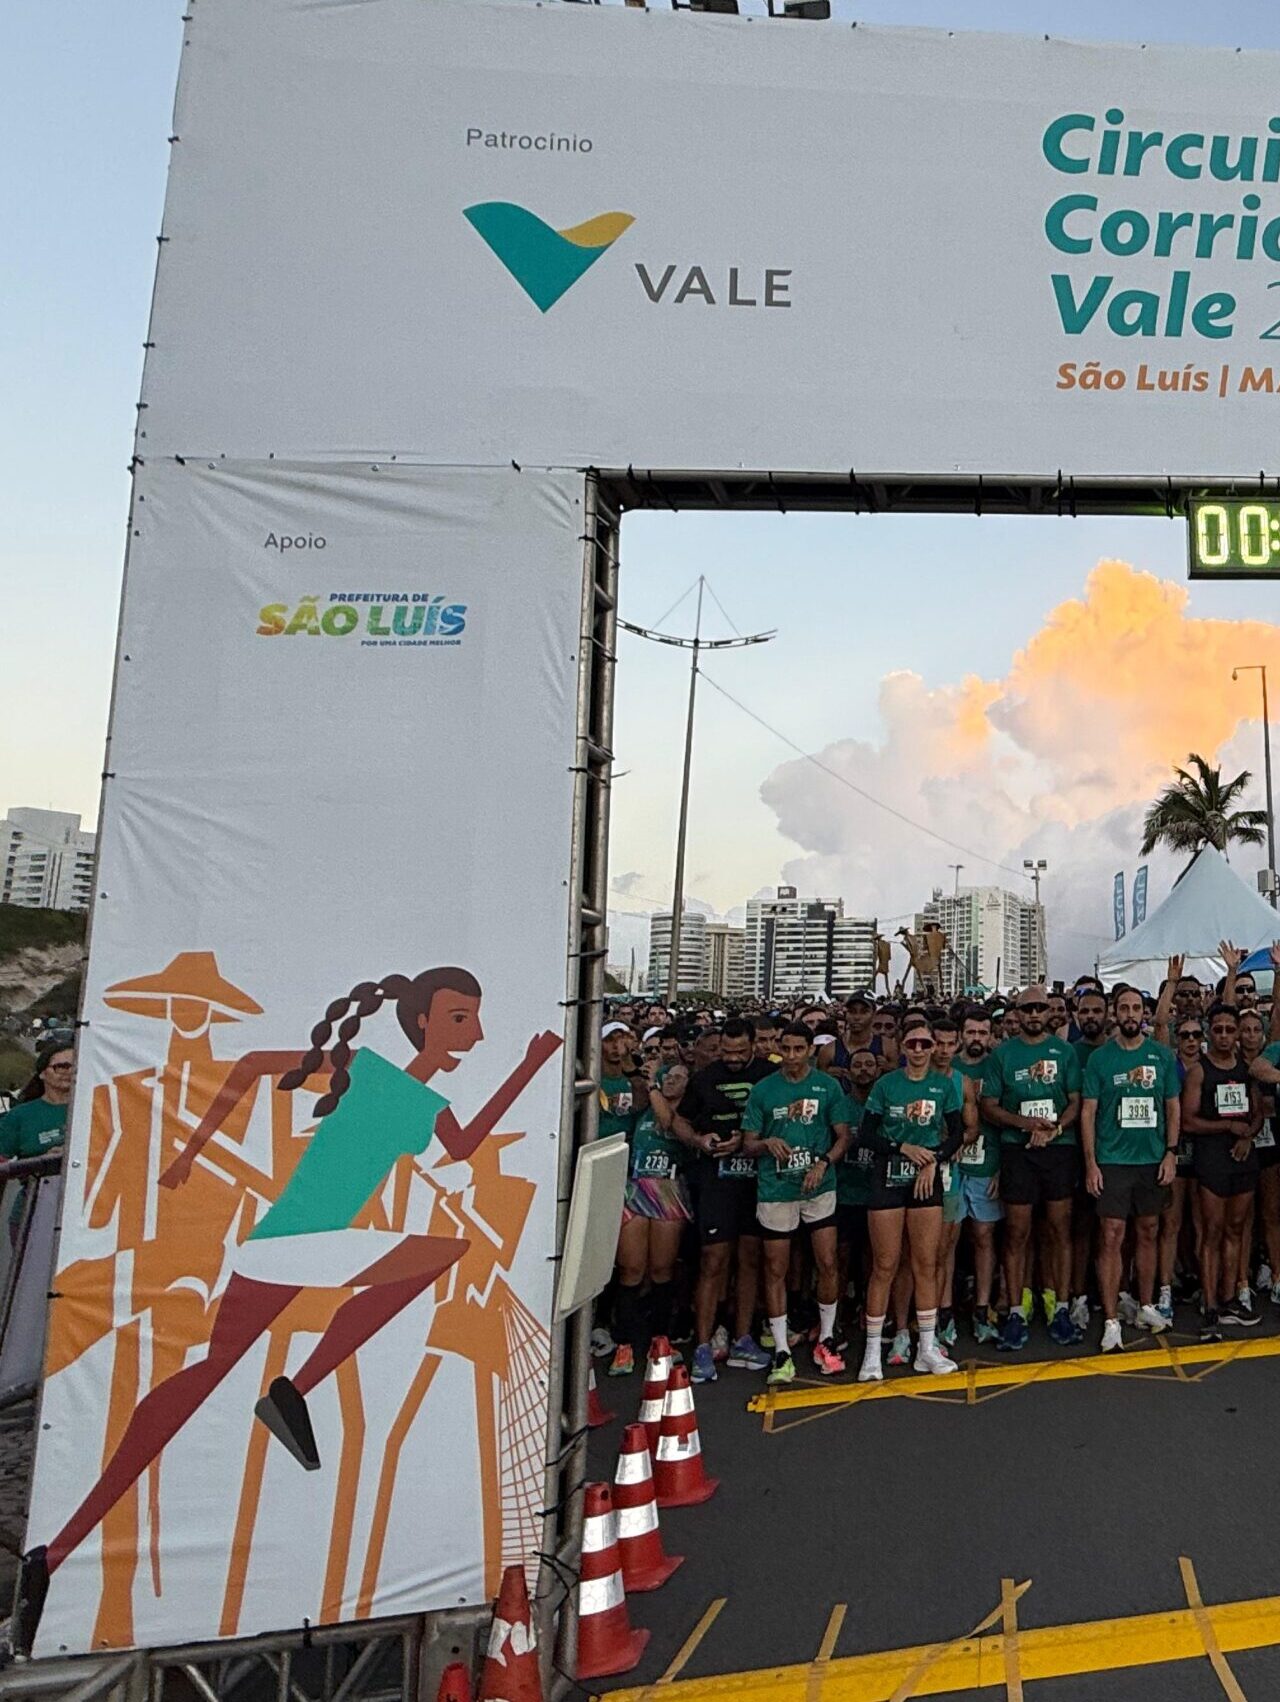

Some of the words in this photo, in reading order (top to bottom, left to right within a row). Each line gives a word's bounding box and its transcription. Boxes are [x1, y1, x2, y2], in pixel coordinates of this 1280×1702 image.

[465, 127, 593, 153] Patrocínio
[635, 263, 793, 308] VALE
[1050, 271, 1237, 339] Vale
[1056, 361, 1126, 392] São
[1136, 364, 1209, 393] Luís
[264, 532, 327, 553] Apoio
[329, 593, 408, 602] PREFEITURA
[412, 593, 429, 602] DE
[256, 595, 359, 636] SÃO
[367, 595, 468, 636] LUÍS
[1224, 1091, 1241, 1104] 4153
[1129, 1105, 1149, 1118] 3936
[645, 1155, 669, 1170] 2739
[788, 1151, 811, 1169] 2556
